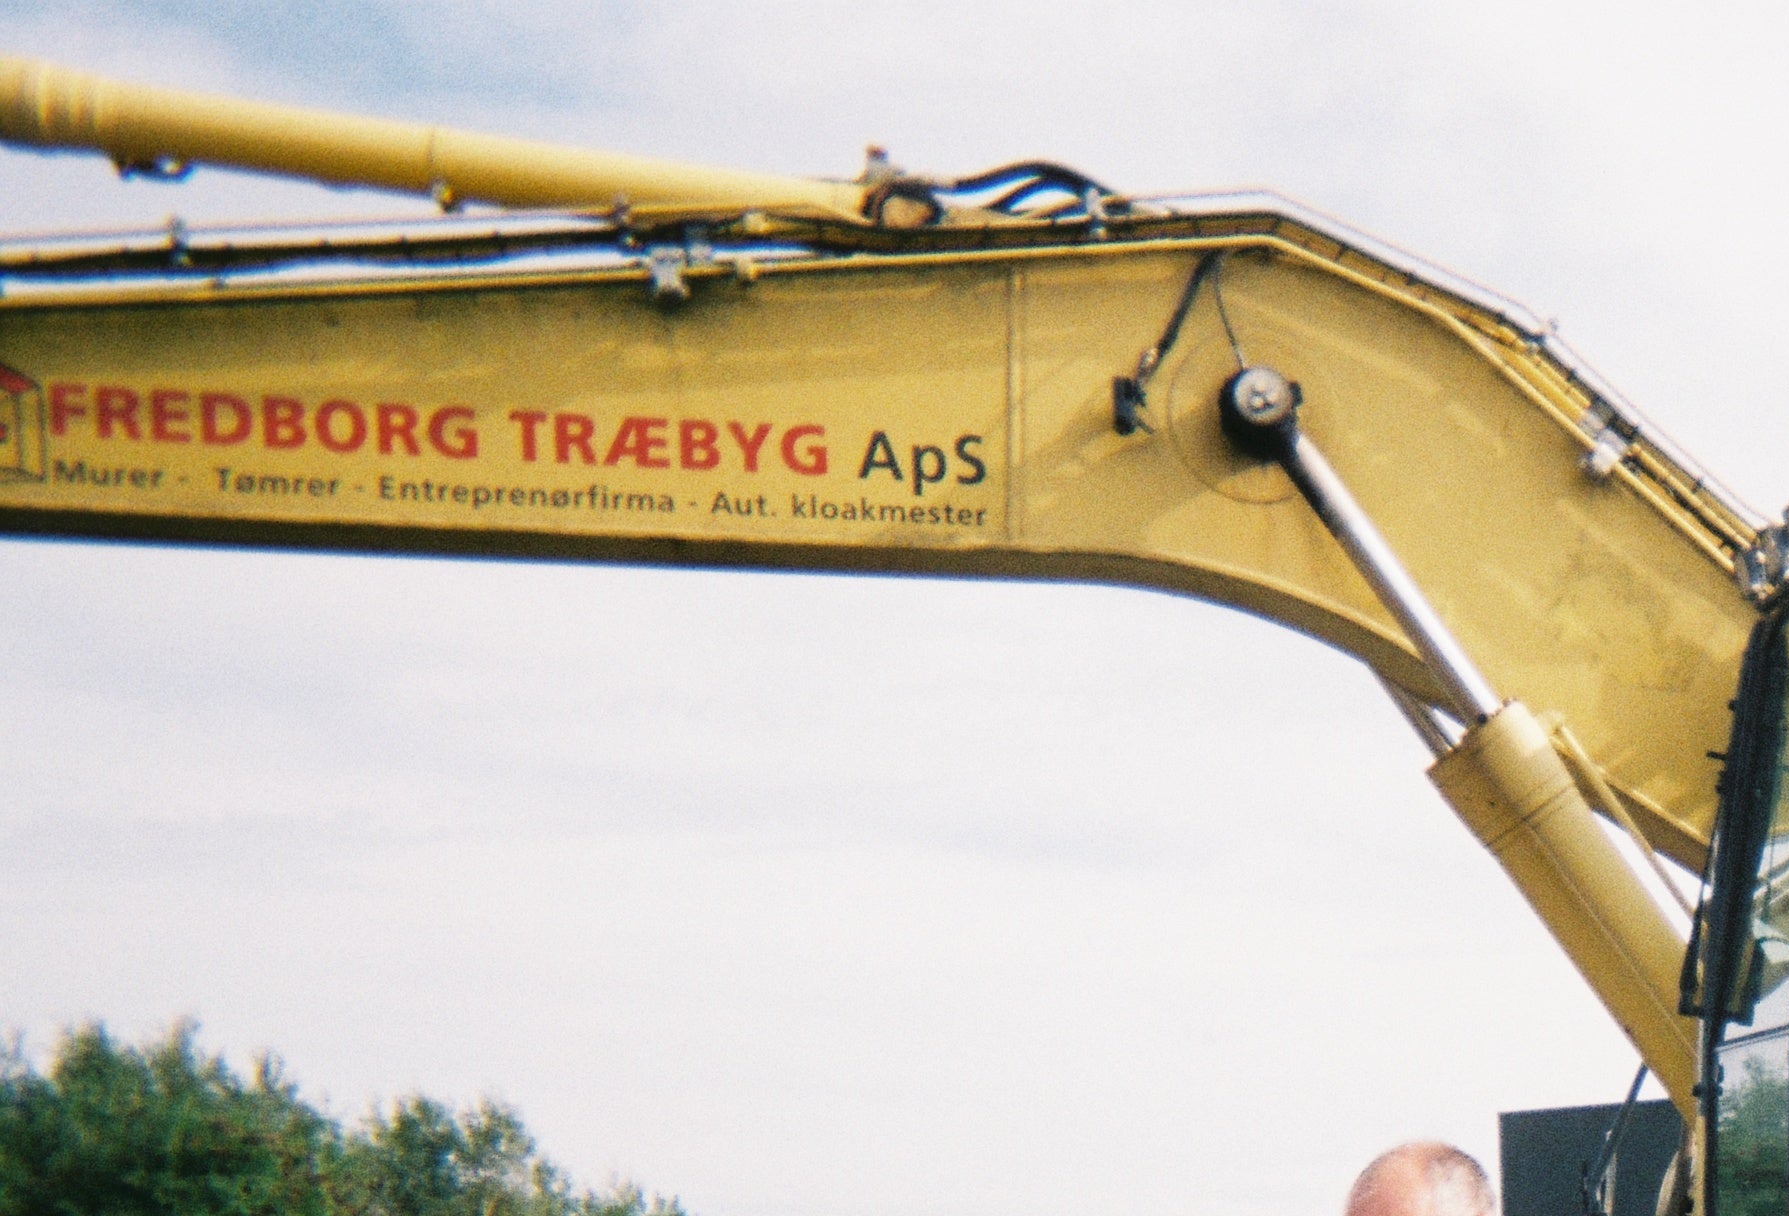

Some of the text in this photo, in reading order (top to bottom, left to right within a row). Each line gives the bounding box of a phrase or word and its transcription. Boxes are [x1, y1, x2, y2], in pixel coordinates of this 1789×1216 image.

[49, 382, 988, 496] FREDBORG TRÆBYG ApS
[53, 459, 164, 488] Murer
[214, 466, 340, 497] Tømrer
[379, 474, 676, 513] Entreprenørfirma
[710, 491, 778, 518] Aut.
[791, 494, 988, 527] kloakmester
